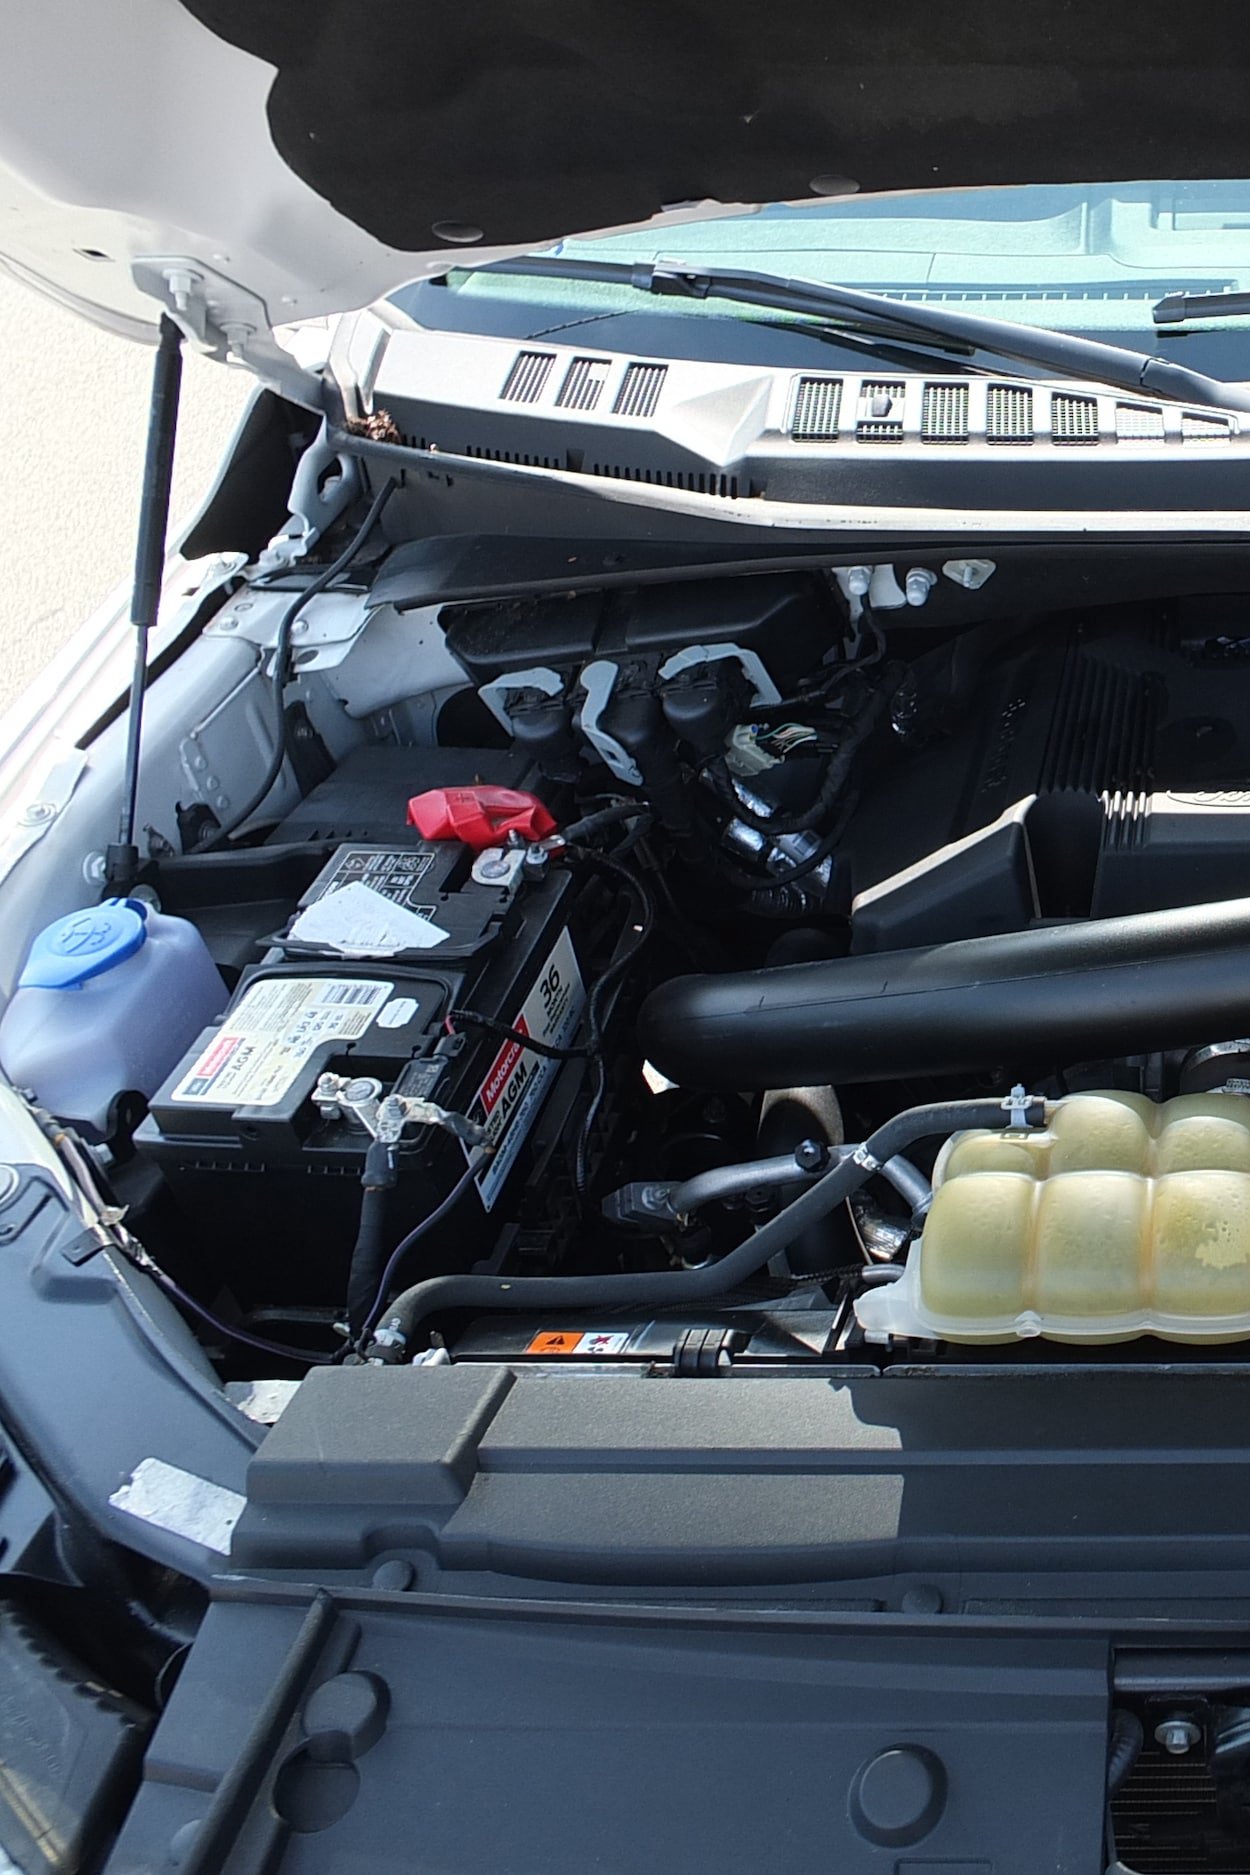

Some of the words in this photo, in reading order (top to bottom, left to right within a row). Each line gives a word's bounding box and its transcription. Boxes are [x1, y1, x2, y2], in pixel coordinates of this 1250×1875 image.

[539, 963, 560, 1008] 36
[234, 1046, 256, 1071] AGM
[486, 1027, 526, 1103] Motorcra
[500, 1061, 528, 1119] AGM
